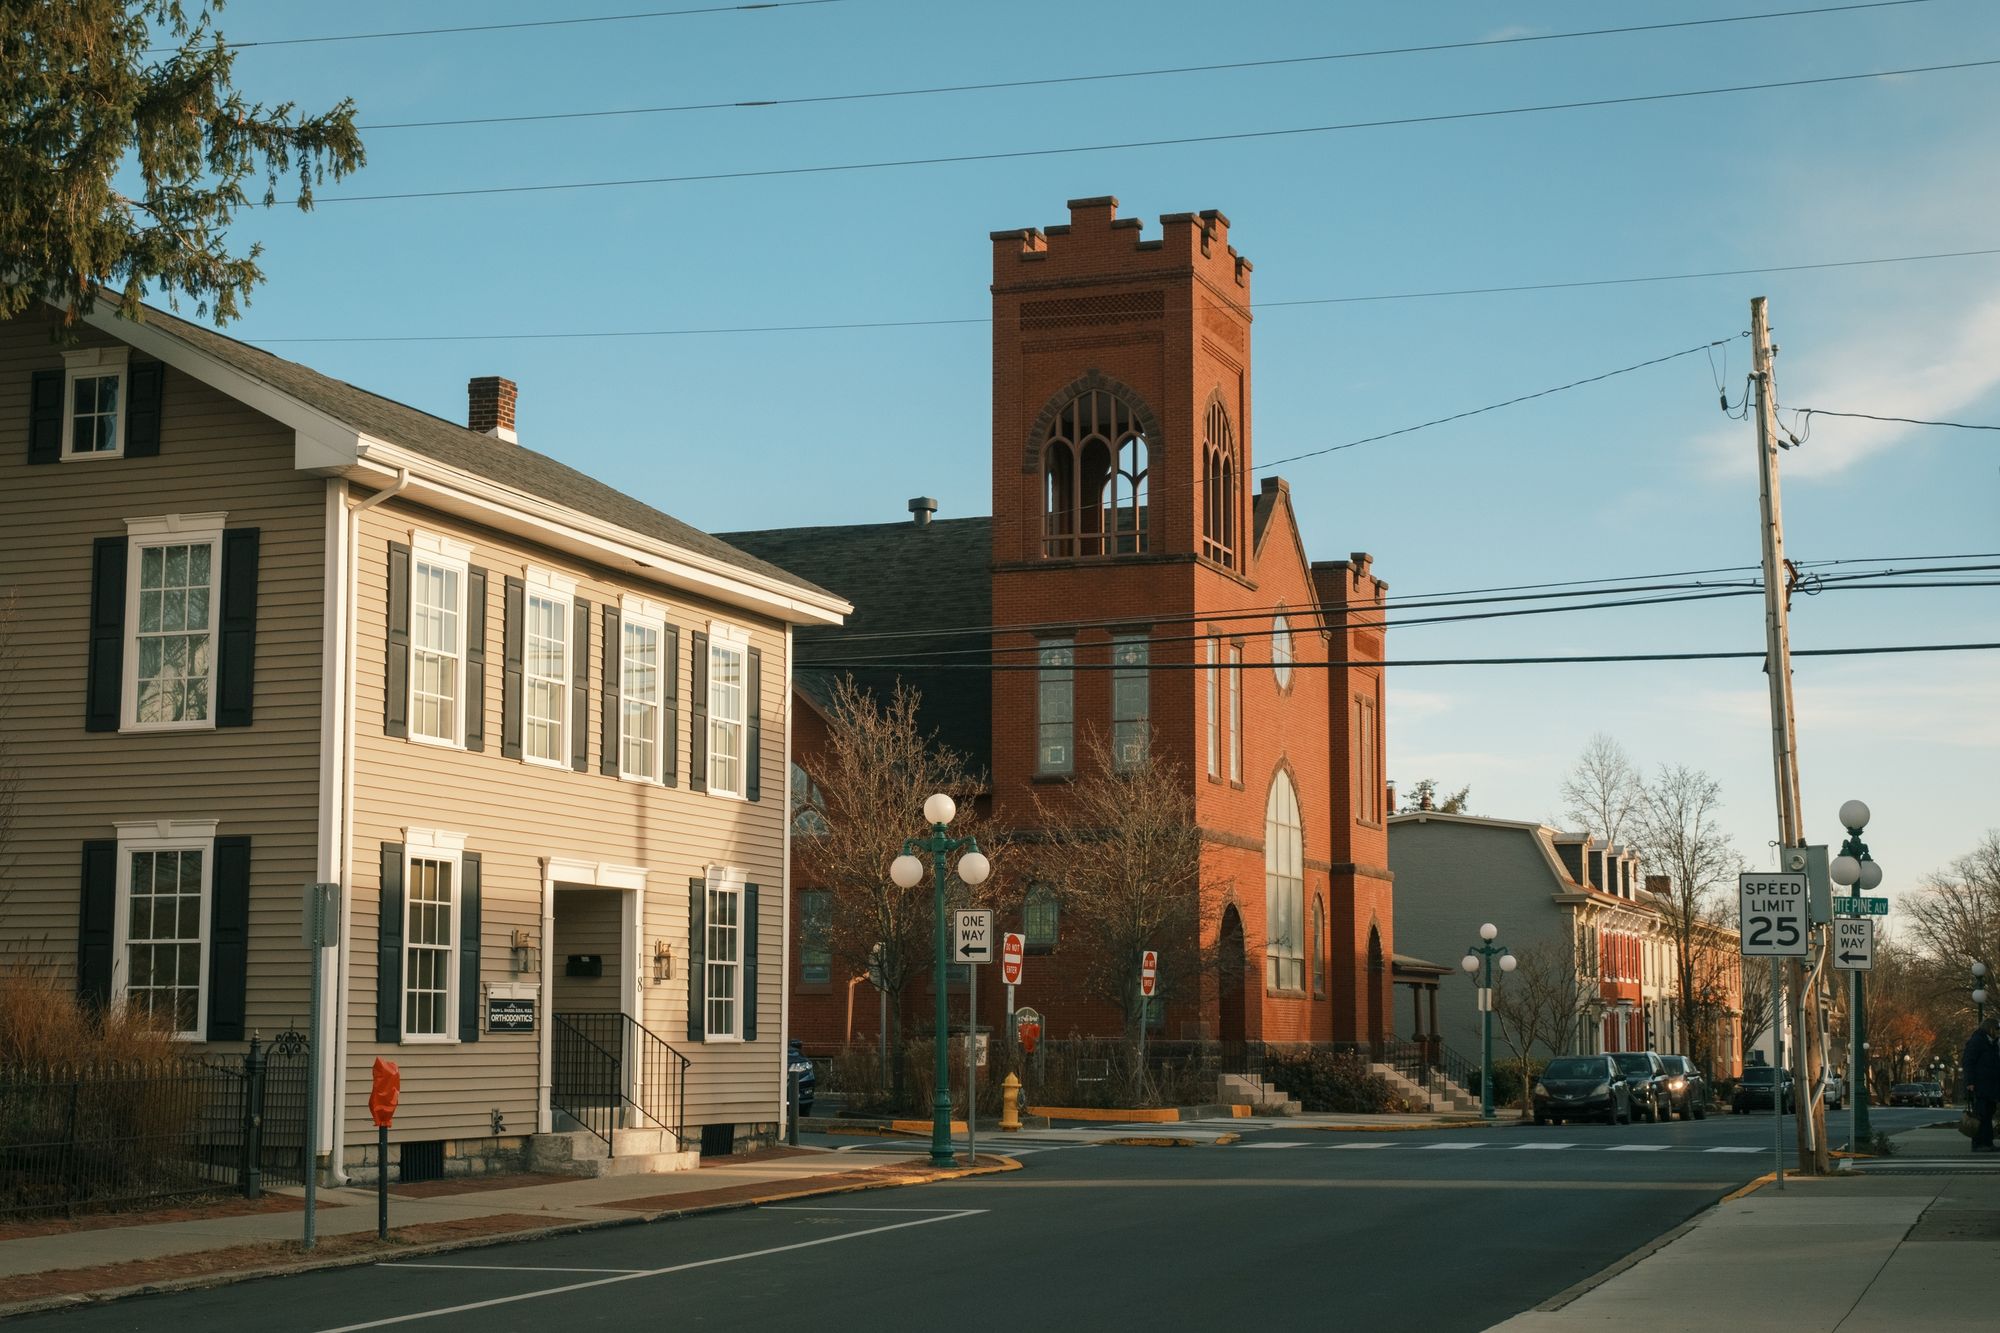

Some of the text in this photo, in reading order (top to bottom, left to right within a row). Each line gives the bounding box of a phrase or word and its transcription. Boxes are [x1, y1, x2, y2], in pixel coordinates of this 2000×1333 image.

[1745, 883, 1800, 896] SPEED
[1751, 900, 1795, 912] LIMIT
[1833, 898, 1887, 914] HITE PINE ALY
[962, 915, 985, 927] ONE
[1748, 916, 1800, 946] 25
[1841, 923, 1865, 935] ONE
[961, 930, 985, 941] WAY
[1005, 943, 1020, 952] DO NOT
[1840, 938, 1865, 949] WAY
[1006, 965, 1017, 974] ENTER
[491, 1014, 533, 1022] ORTHODONTICS
